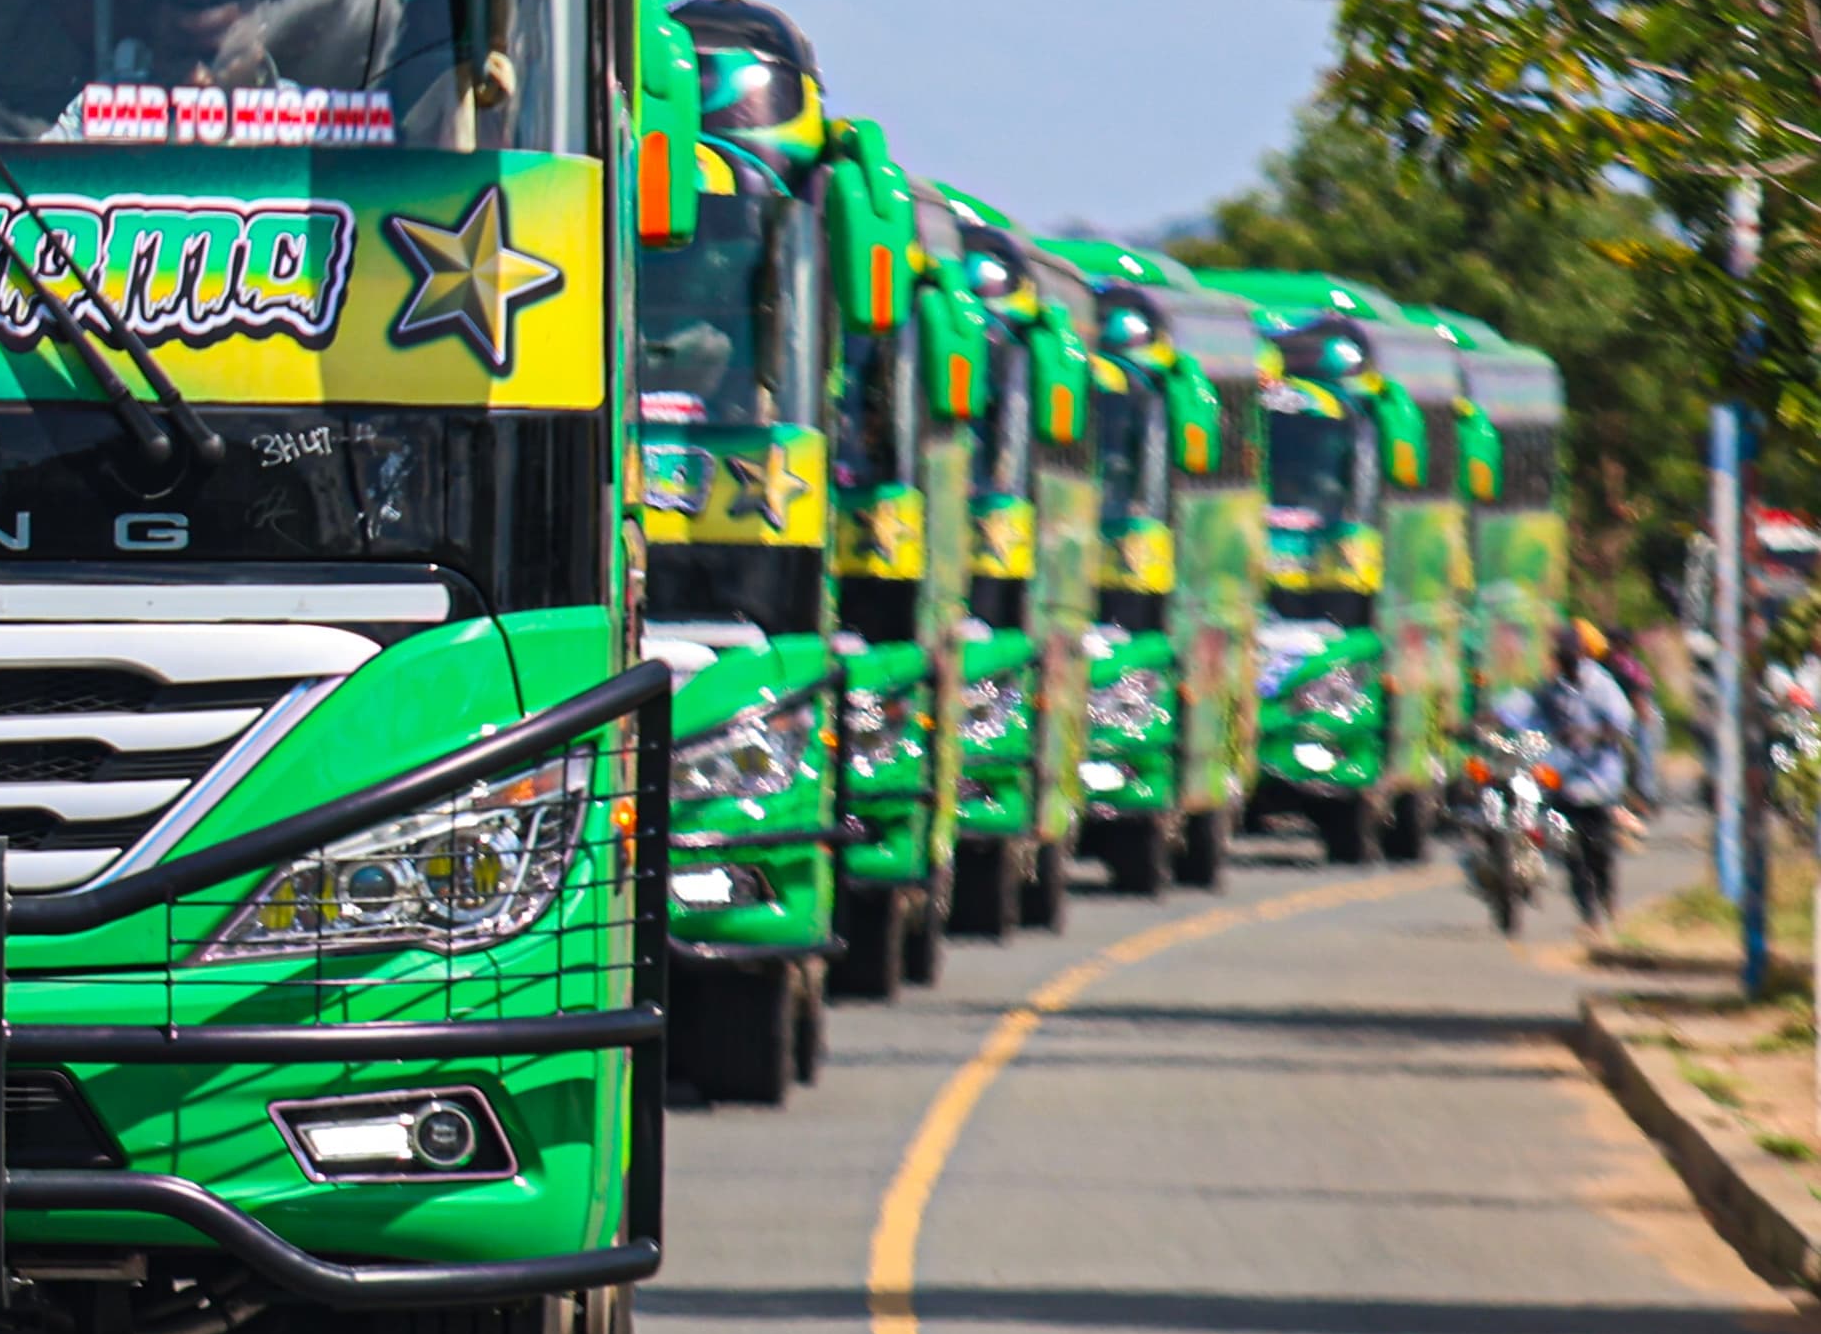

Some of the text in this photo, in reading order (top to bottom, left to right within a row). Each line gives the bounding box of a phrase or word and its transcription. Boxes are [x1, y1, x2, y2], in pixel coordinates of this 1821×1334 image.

[83, 83, 396, 147] DAR TO KIGOMA
